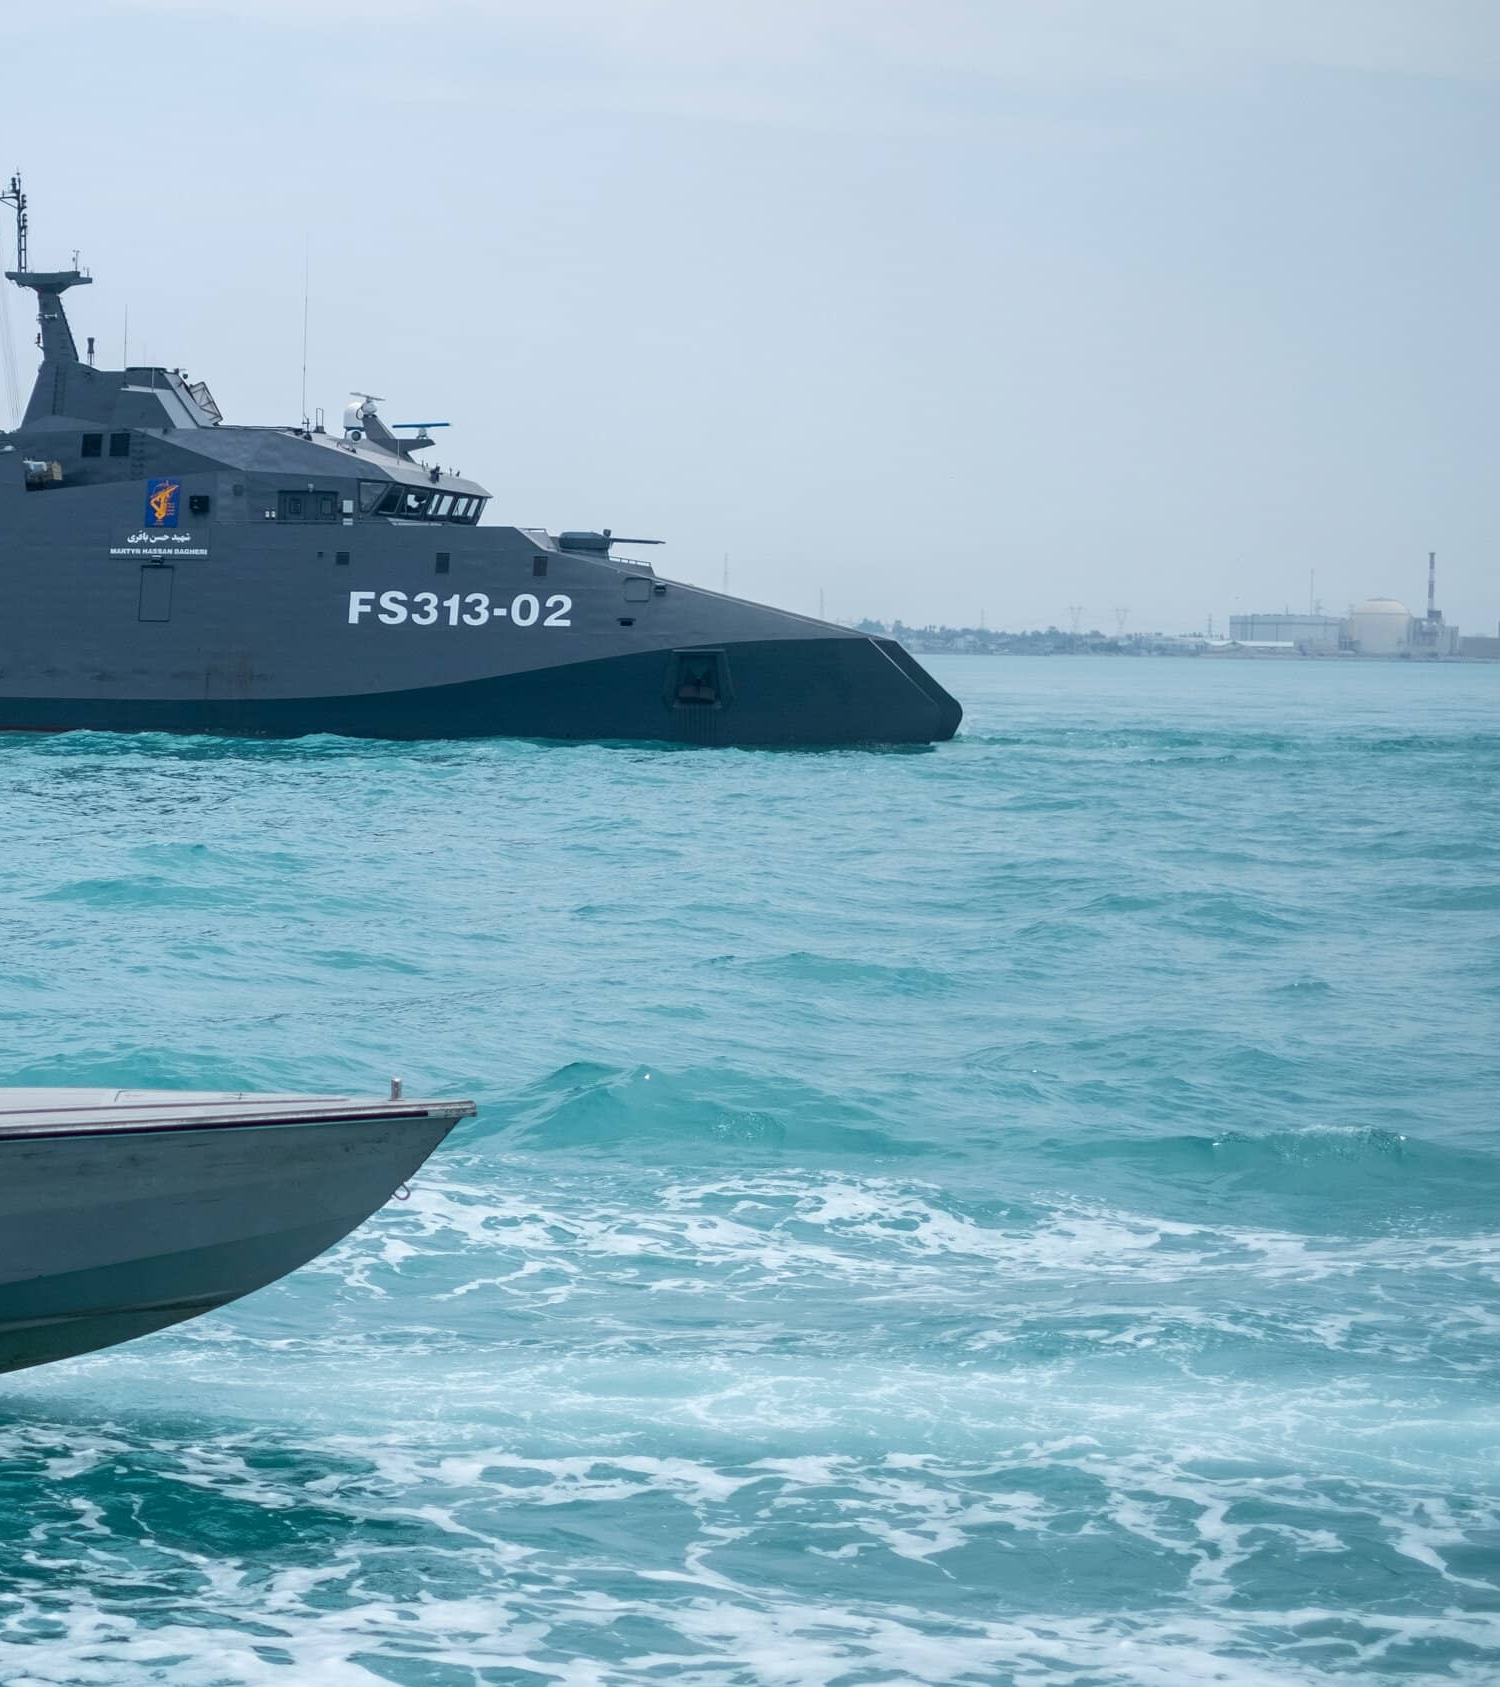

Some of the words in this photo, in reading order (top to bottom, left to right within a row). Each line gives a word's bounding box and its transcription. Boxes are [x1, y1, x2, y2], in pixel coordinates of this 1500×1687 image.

[127, 530, 148, 543] باقری
[149, 533, 169, 543] حسن
[171, 532, 191, 543] شهید
[174, 548, 208, 556] BAGHERI
[348, 590, 573, 627] FS313-02
